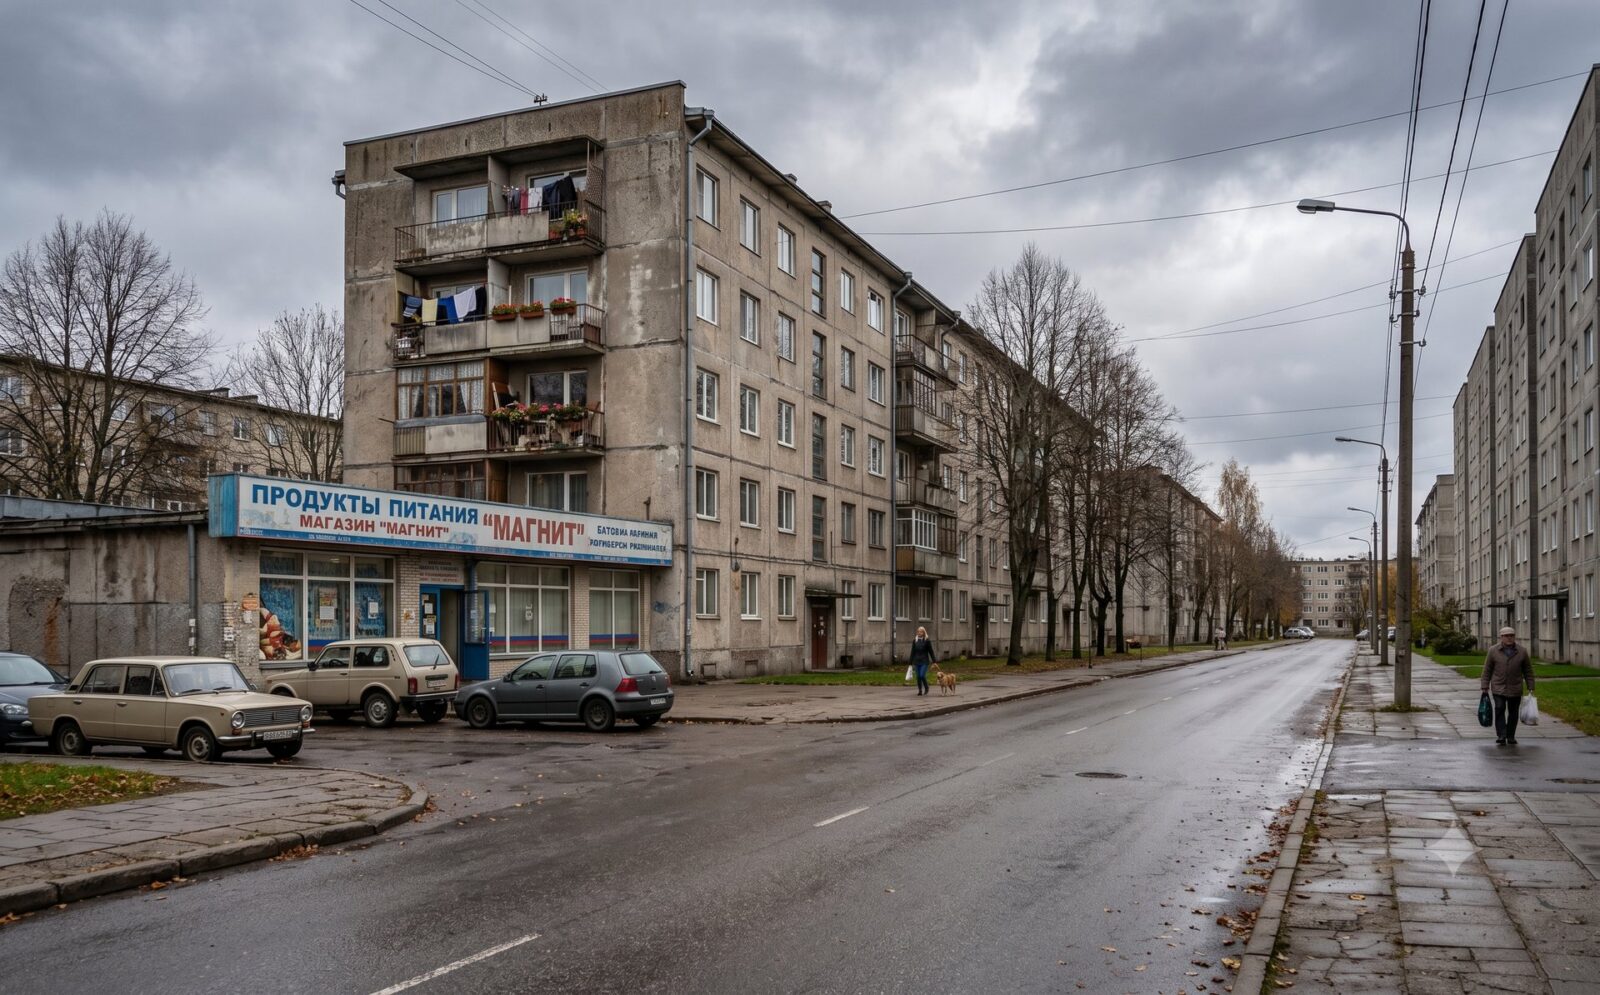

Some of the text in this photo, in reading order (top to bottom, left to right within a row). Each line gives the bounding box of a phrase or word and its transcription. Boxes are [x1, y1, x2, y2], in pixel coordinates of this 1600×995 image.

[252, 484, 478, 525] ПРОДУКТЫ ПИТАНИЯ
[300, 514, 449, 539] МАГАЗИН "МАГНИТ"
